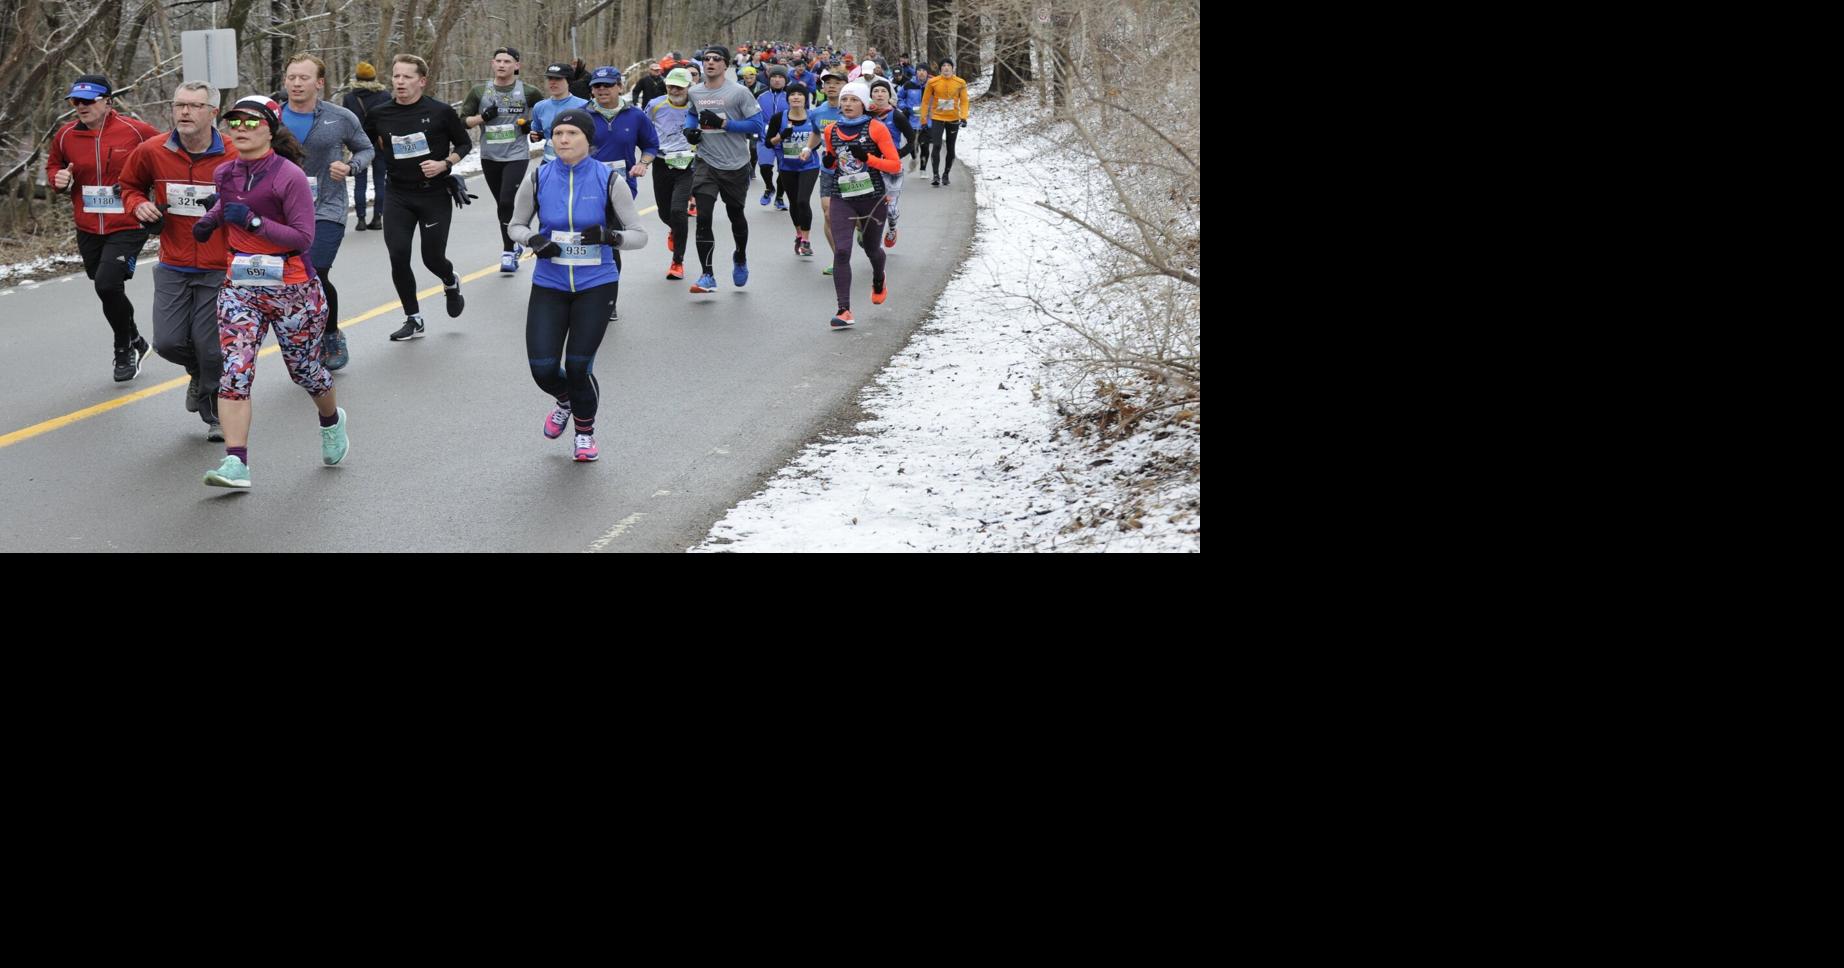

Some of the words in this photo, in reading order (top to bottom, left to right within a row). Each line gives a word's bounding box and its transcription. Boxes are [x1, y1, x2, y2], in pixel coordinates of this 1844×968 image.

[93, 197, 114, 205] 1180
[566, 246, 587, 256] 935
[246, 268, 266, 277] 697
